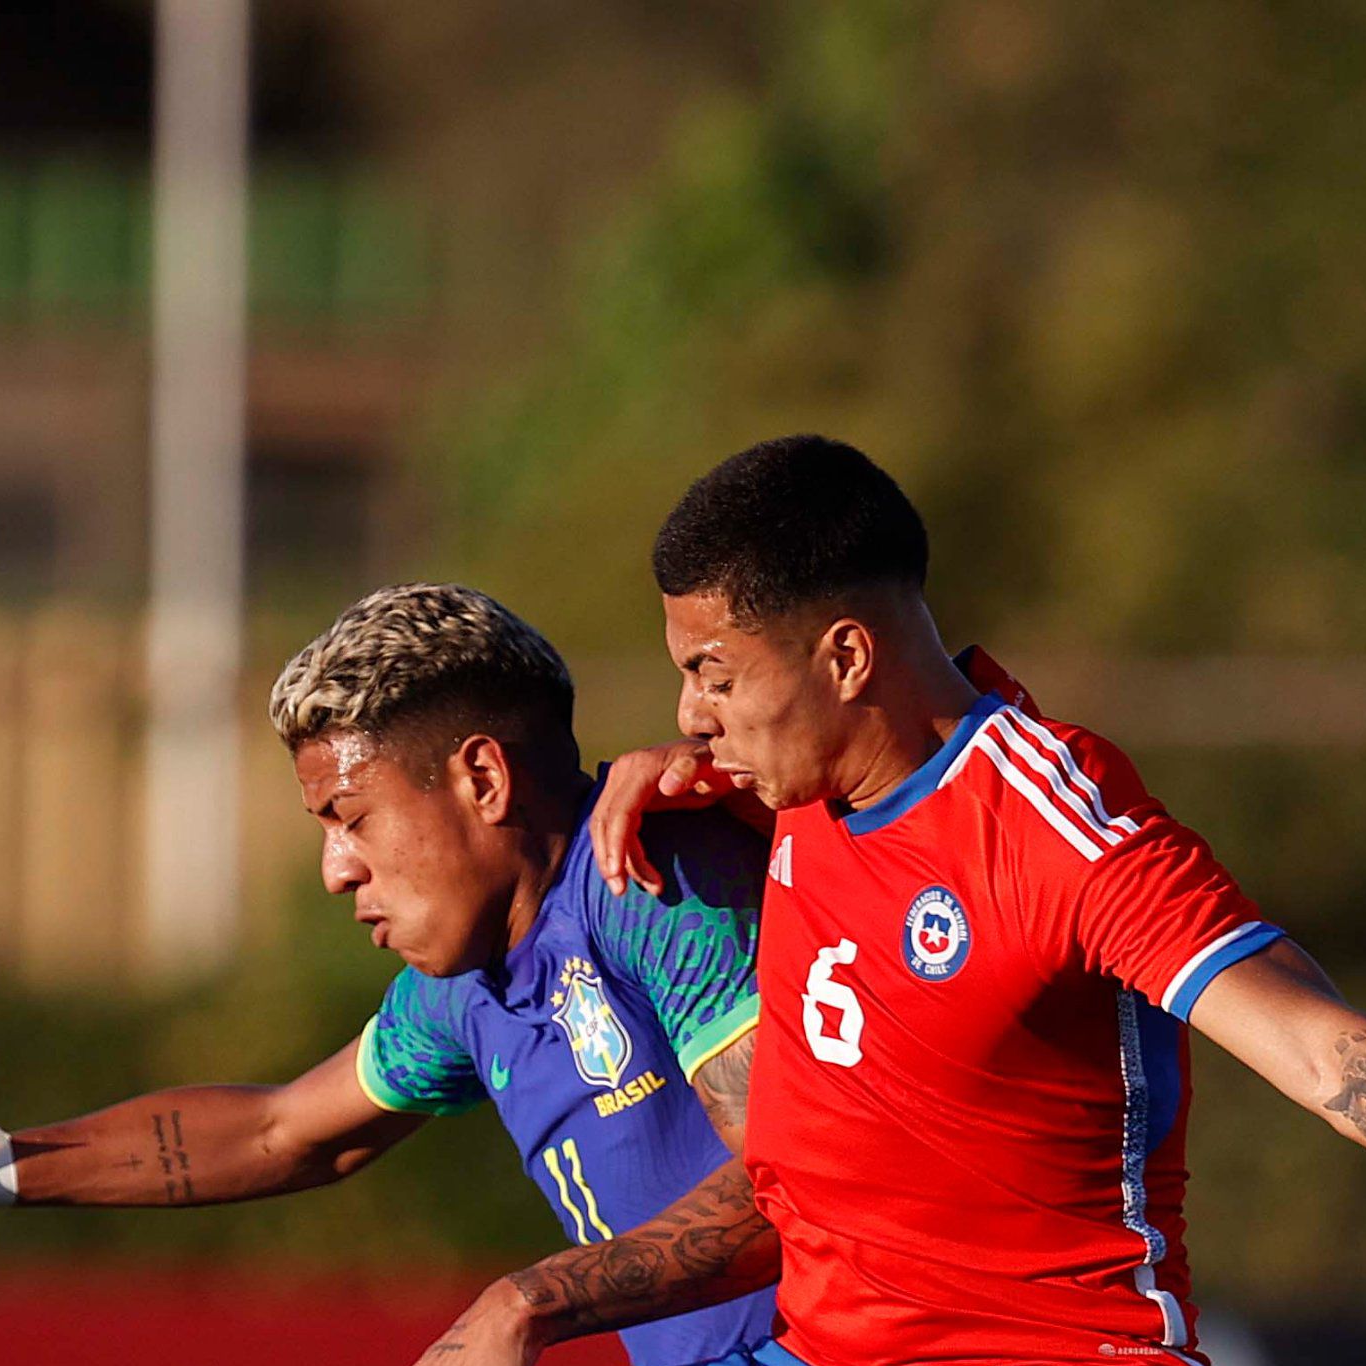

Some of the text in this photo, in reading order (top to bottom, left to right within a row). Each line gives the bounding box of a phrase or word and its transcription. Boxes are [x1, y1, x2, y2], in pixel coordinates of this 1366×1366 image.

[801, 937, 865, 1068] 6
[593, 1071, 667, 1118] BRASIL
[542, 1138, 614, 1246] 11
